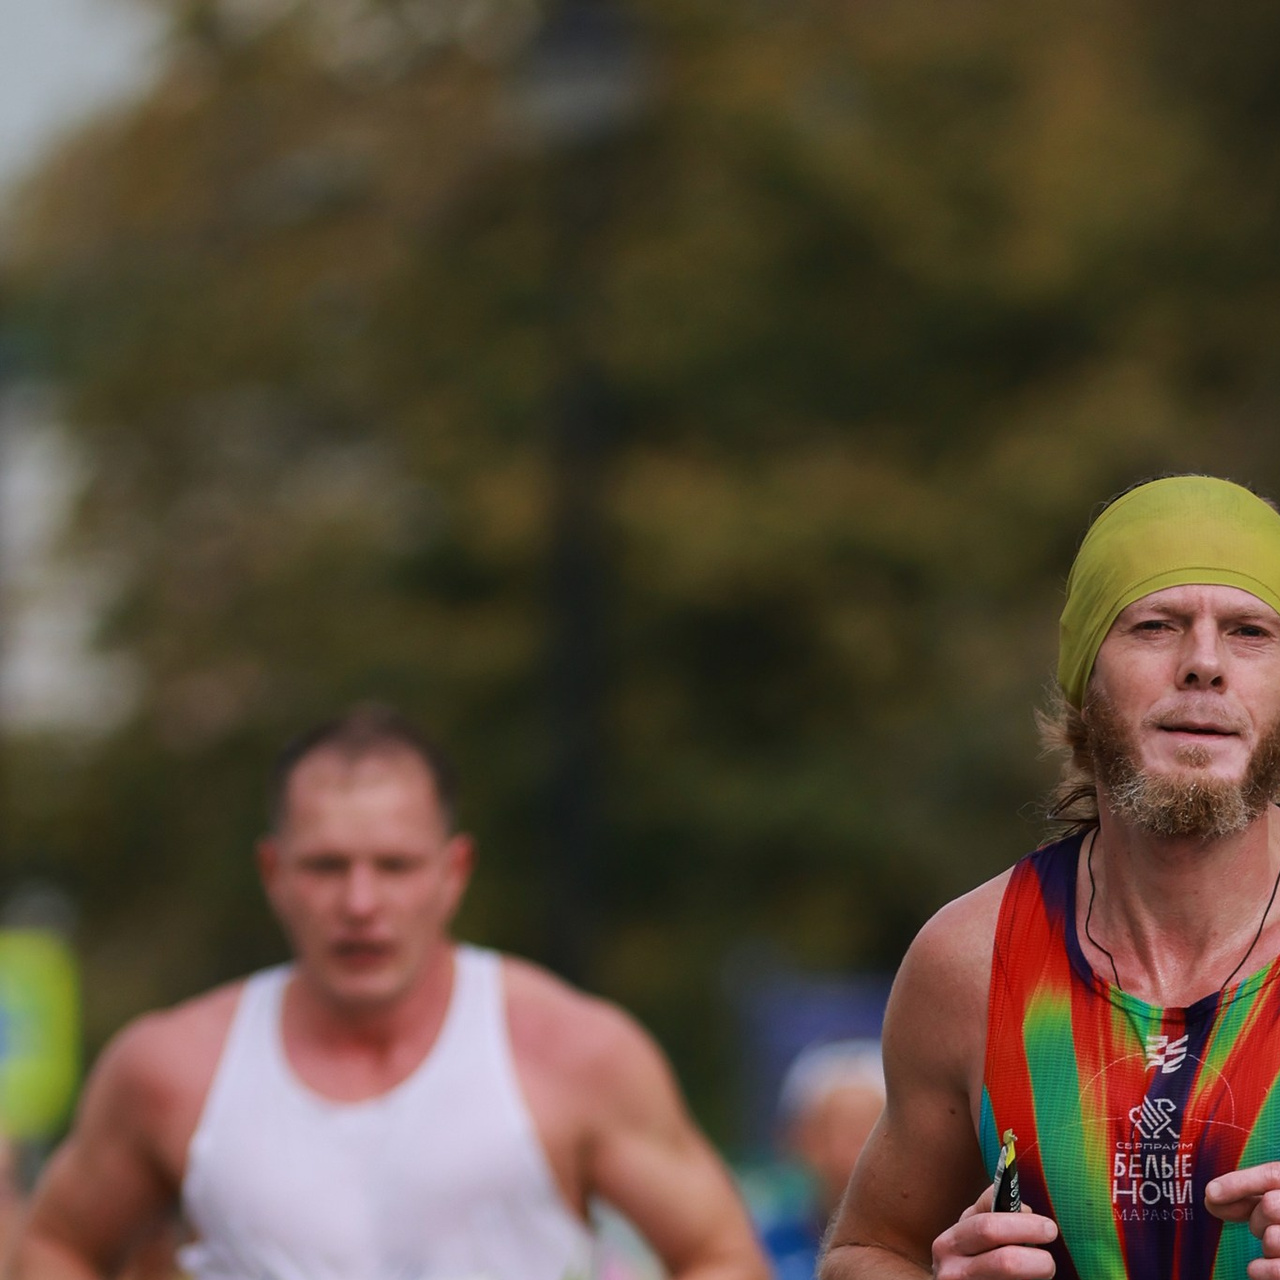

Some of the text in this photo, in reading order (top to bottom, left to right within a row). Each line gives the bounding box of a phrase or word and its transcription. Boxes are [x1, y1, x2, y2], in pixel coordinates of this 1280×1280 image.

[1116, 1141, 1193, 1151] СБРПРАЙМ
[1114, 1153, 1192, 1178] БЕЛЫЕ
[1112, 1180, 1193, 1205] НОЧИ
[1113, 1208, 1194, 1222] МАРАФОН
